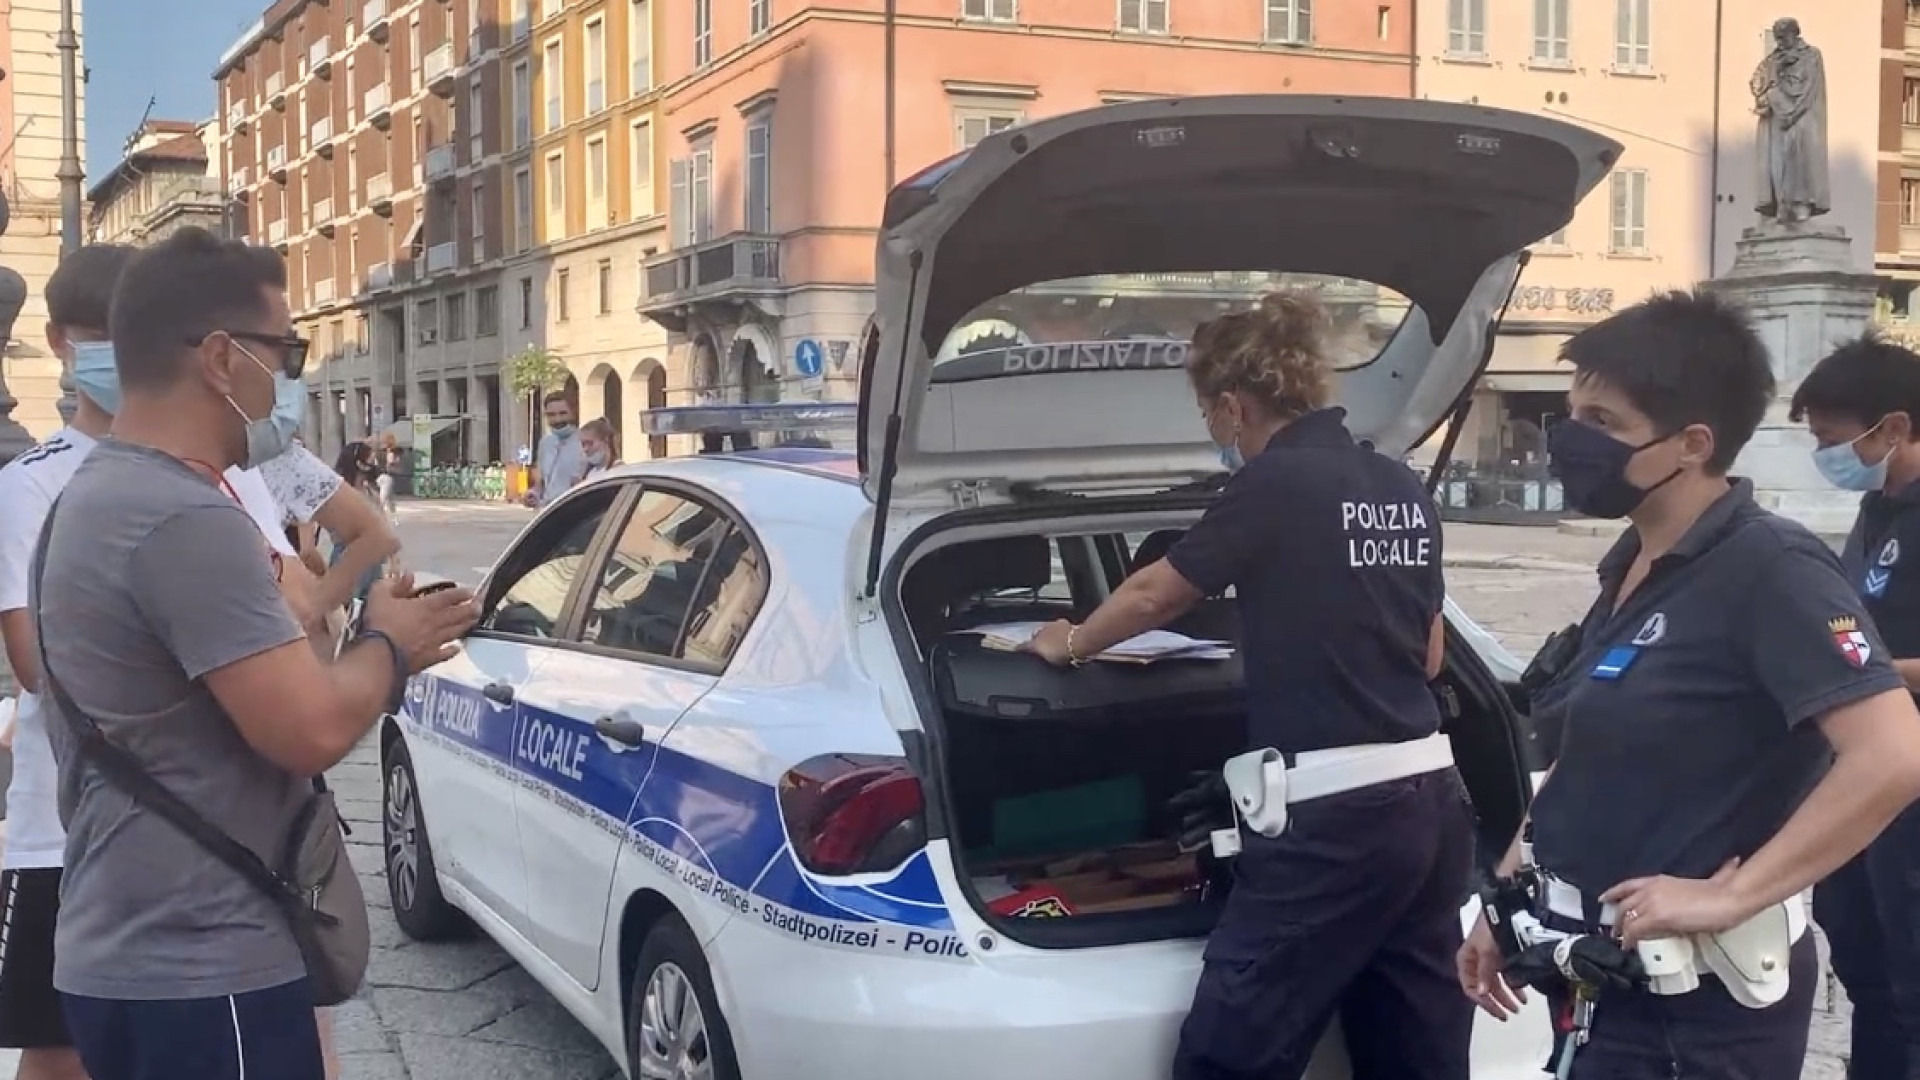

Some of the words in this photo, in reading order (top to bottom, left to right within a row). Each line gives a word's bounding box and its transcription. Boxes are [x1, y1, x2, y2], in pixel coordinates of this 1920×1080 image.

[1342, 502, 1427, 530] POLIZIA
[1349, 538, 1430, 567] LOCALE
[436, 689, 480, 739] POLIZIA
[518, 715, 590, 782] LOCALE
[682, 865, 713, 894] Local
[711, 880, 749, 914] Police
[762, 903, 879, 949] Stadtpolizei
